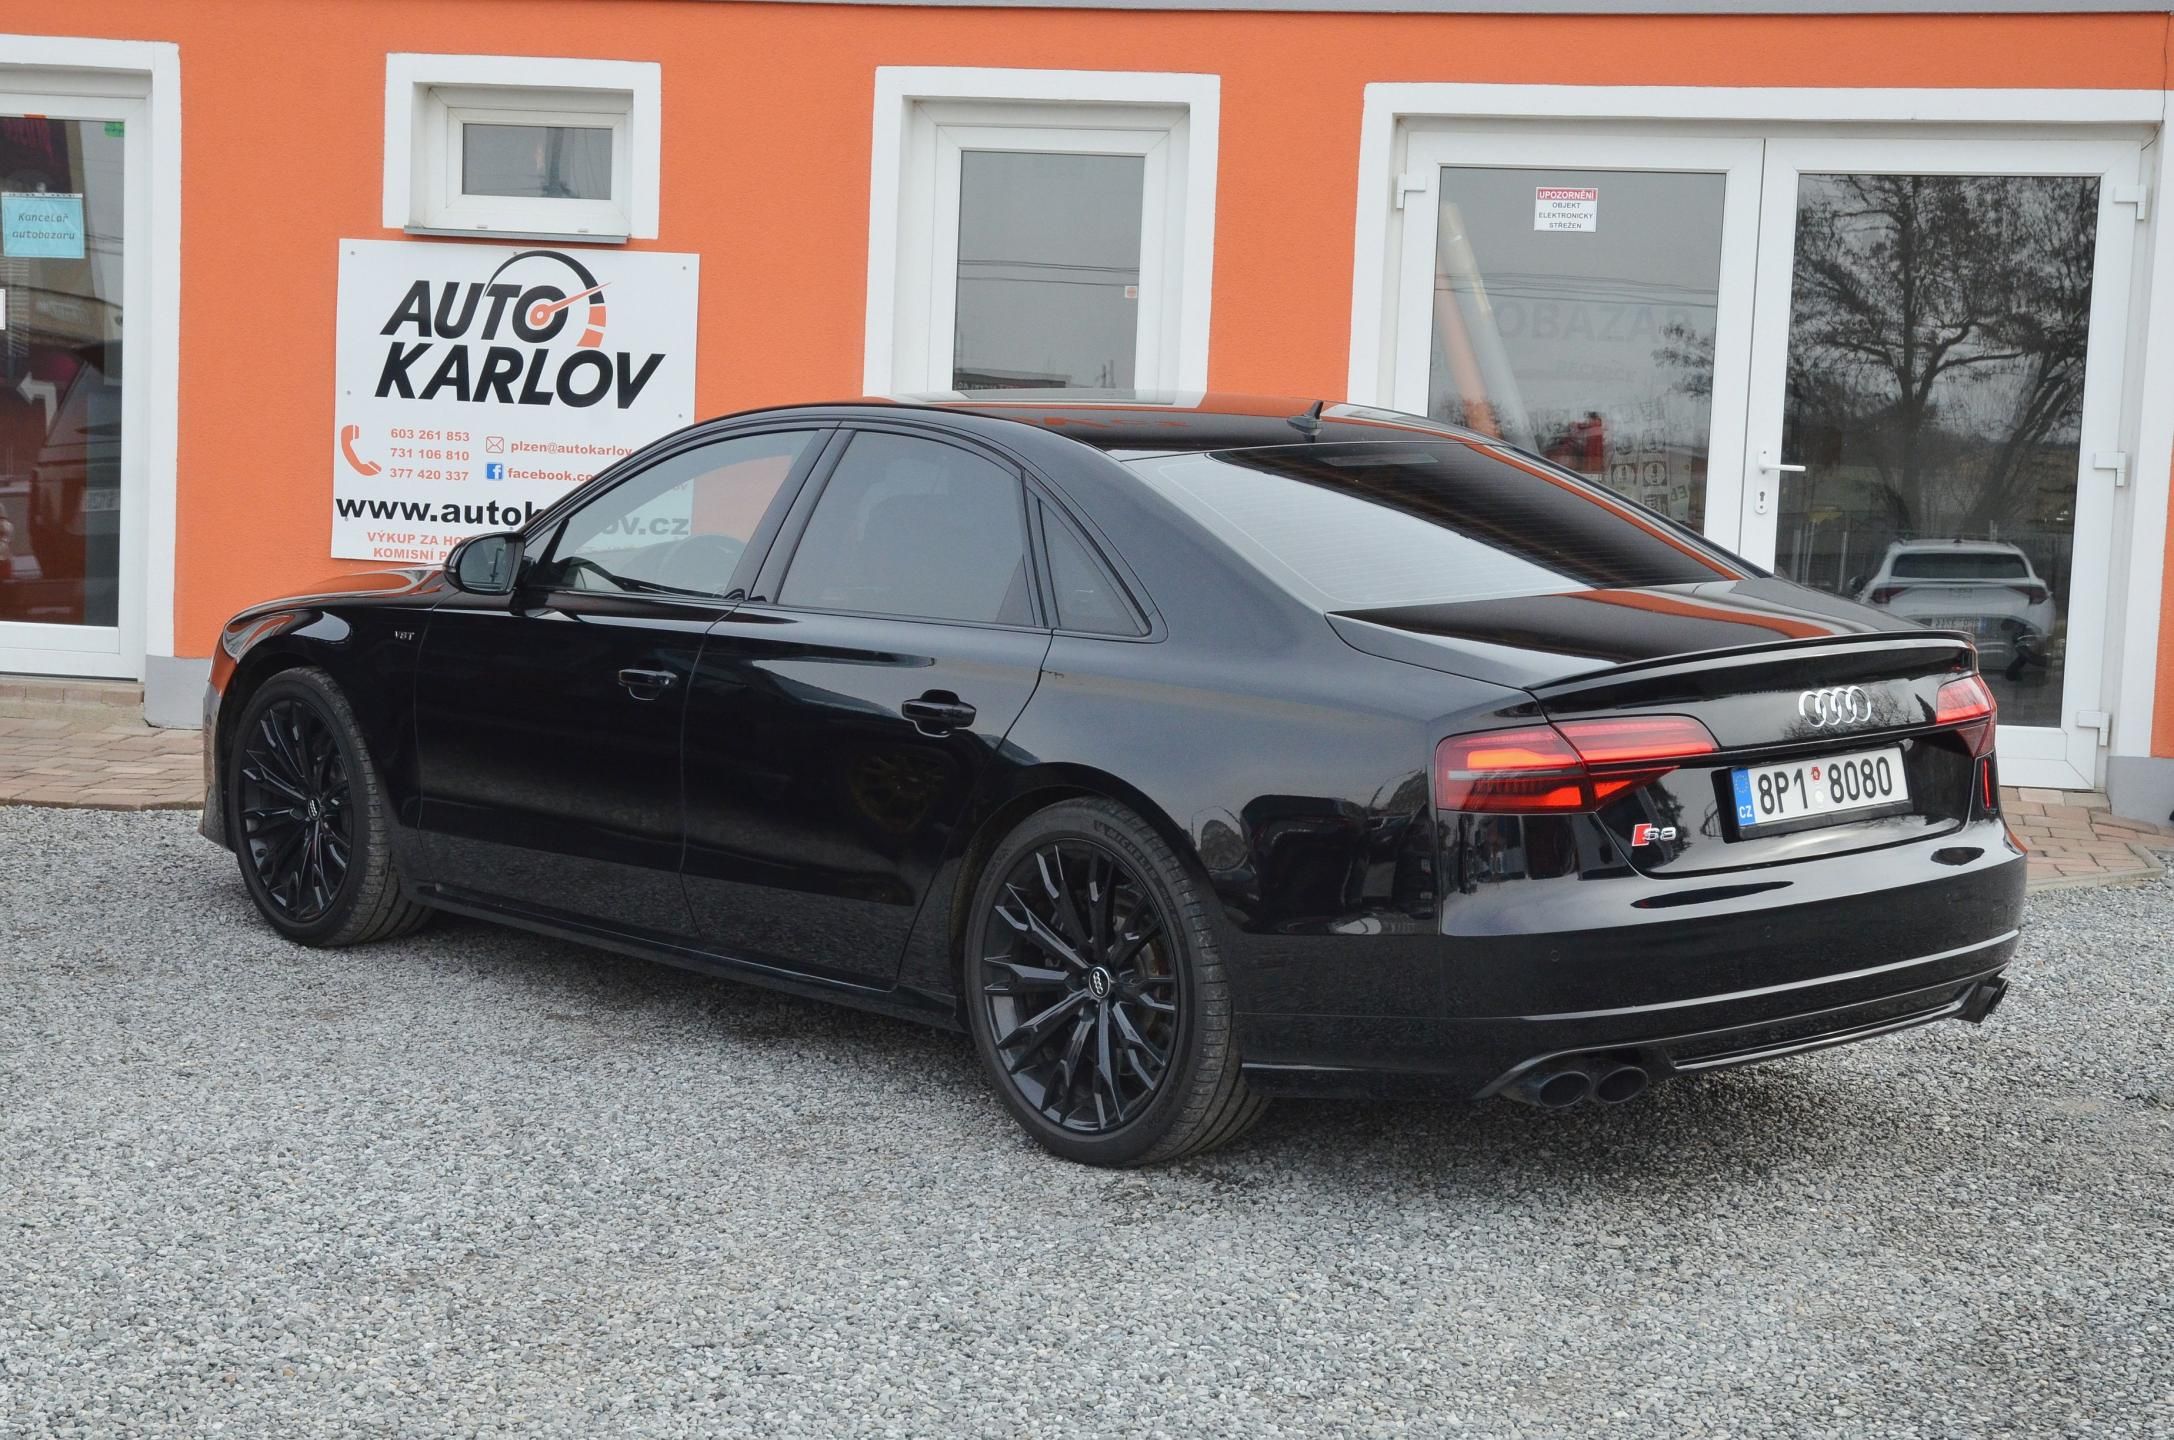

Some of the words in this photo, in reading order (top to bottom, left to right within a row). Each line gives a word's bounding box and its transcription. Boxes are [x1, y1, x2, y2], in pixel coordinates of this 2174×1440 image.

[1539, 190, 1594, 200] UPOZORNĚNÍ
[1552, 201, 1581, 209] OBJEKT
[1538, 211, 1593, 219] ELEKTRONICKY
[1548, 220, 1582, 229] STŘEŽEN
[12, 230, 75, 241] autobazaru
[379, 279, 569, 344] AUTO
[374, 341, 667, 410] KARLOV
[390, 428, 414, 440] 603
[418, 430, 441, 441] 261
[446, 431, 470, 442] 853
[390, 447, 413, 458] 731
[418, 449, 442, 460] 106
[445, 450, 470, 461] 810
[510, 440, 633, 457] plzen@autokarlov
[389, 467, 413, 479] 377
[417, 469, 442, 480] 420
[445, 470, 469, 481] 337
[507, 467, 594, 482] facebook.co
[367, 529, 416, 544] VÝKUP
[420, 534, 439, 545] ZA
[373, 547, 434, 561] KOMISNÍ
[1757, 768, 1808, 816] 8P1
[1827, 755, 1893, 804] 8080
[1738, 804, 1754, 819] CZ
[1643, 826, 1676, 841] S8
